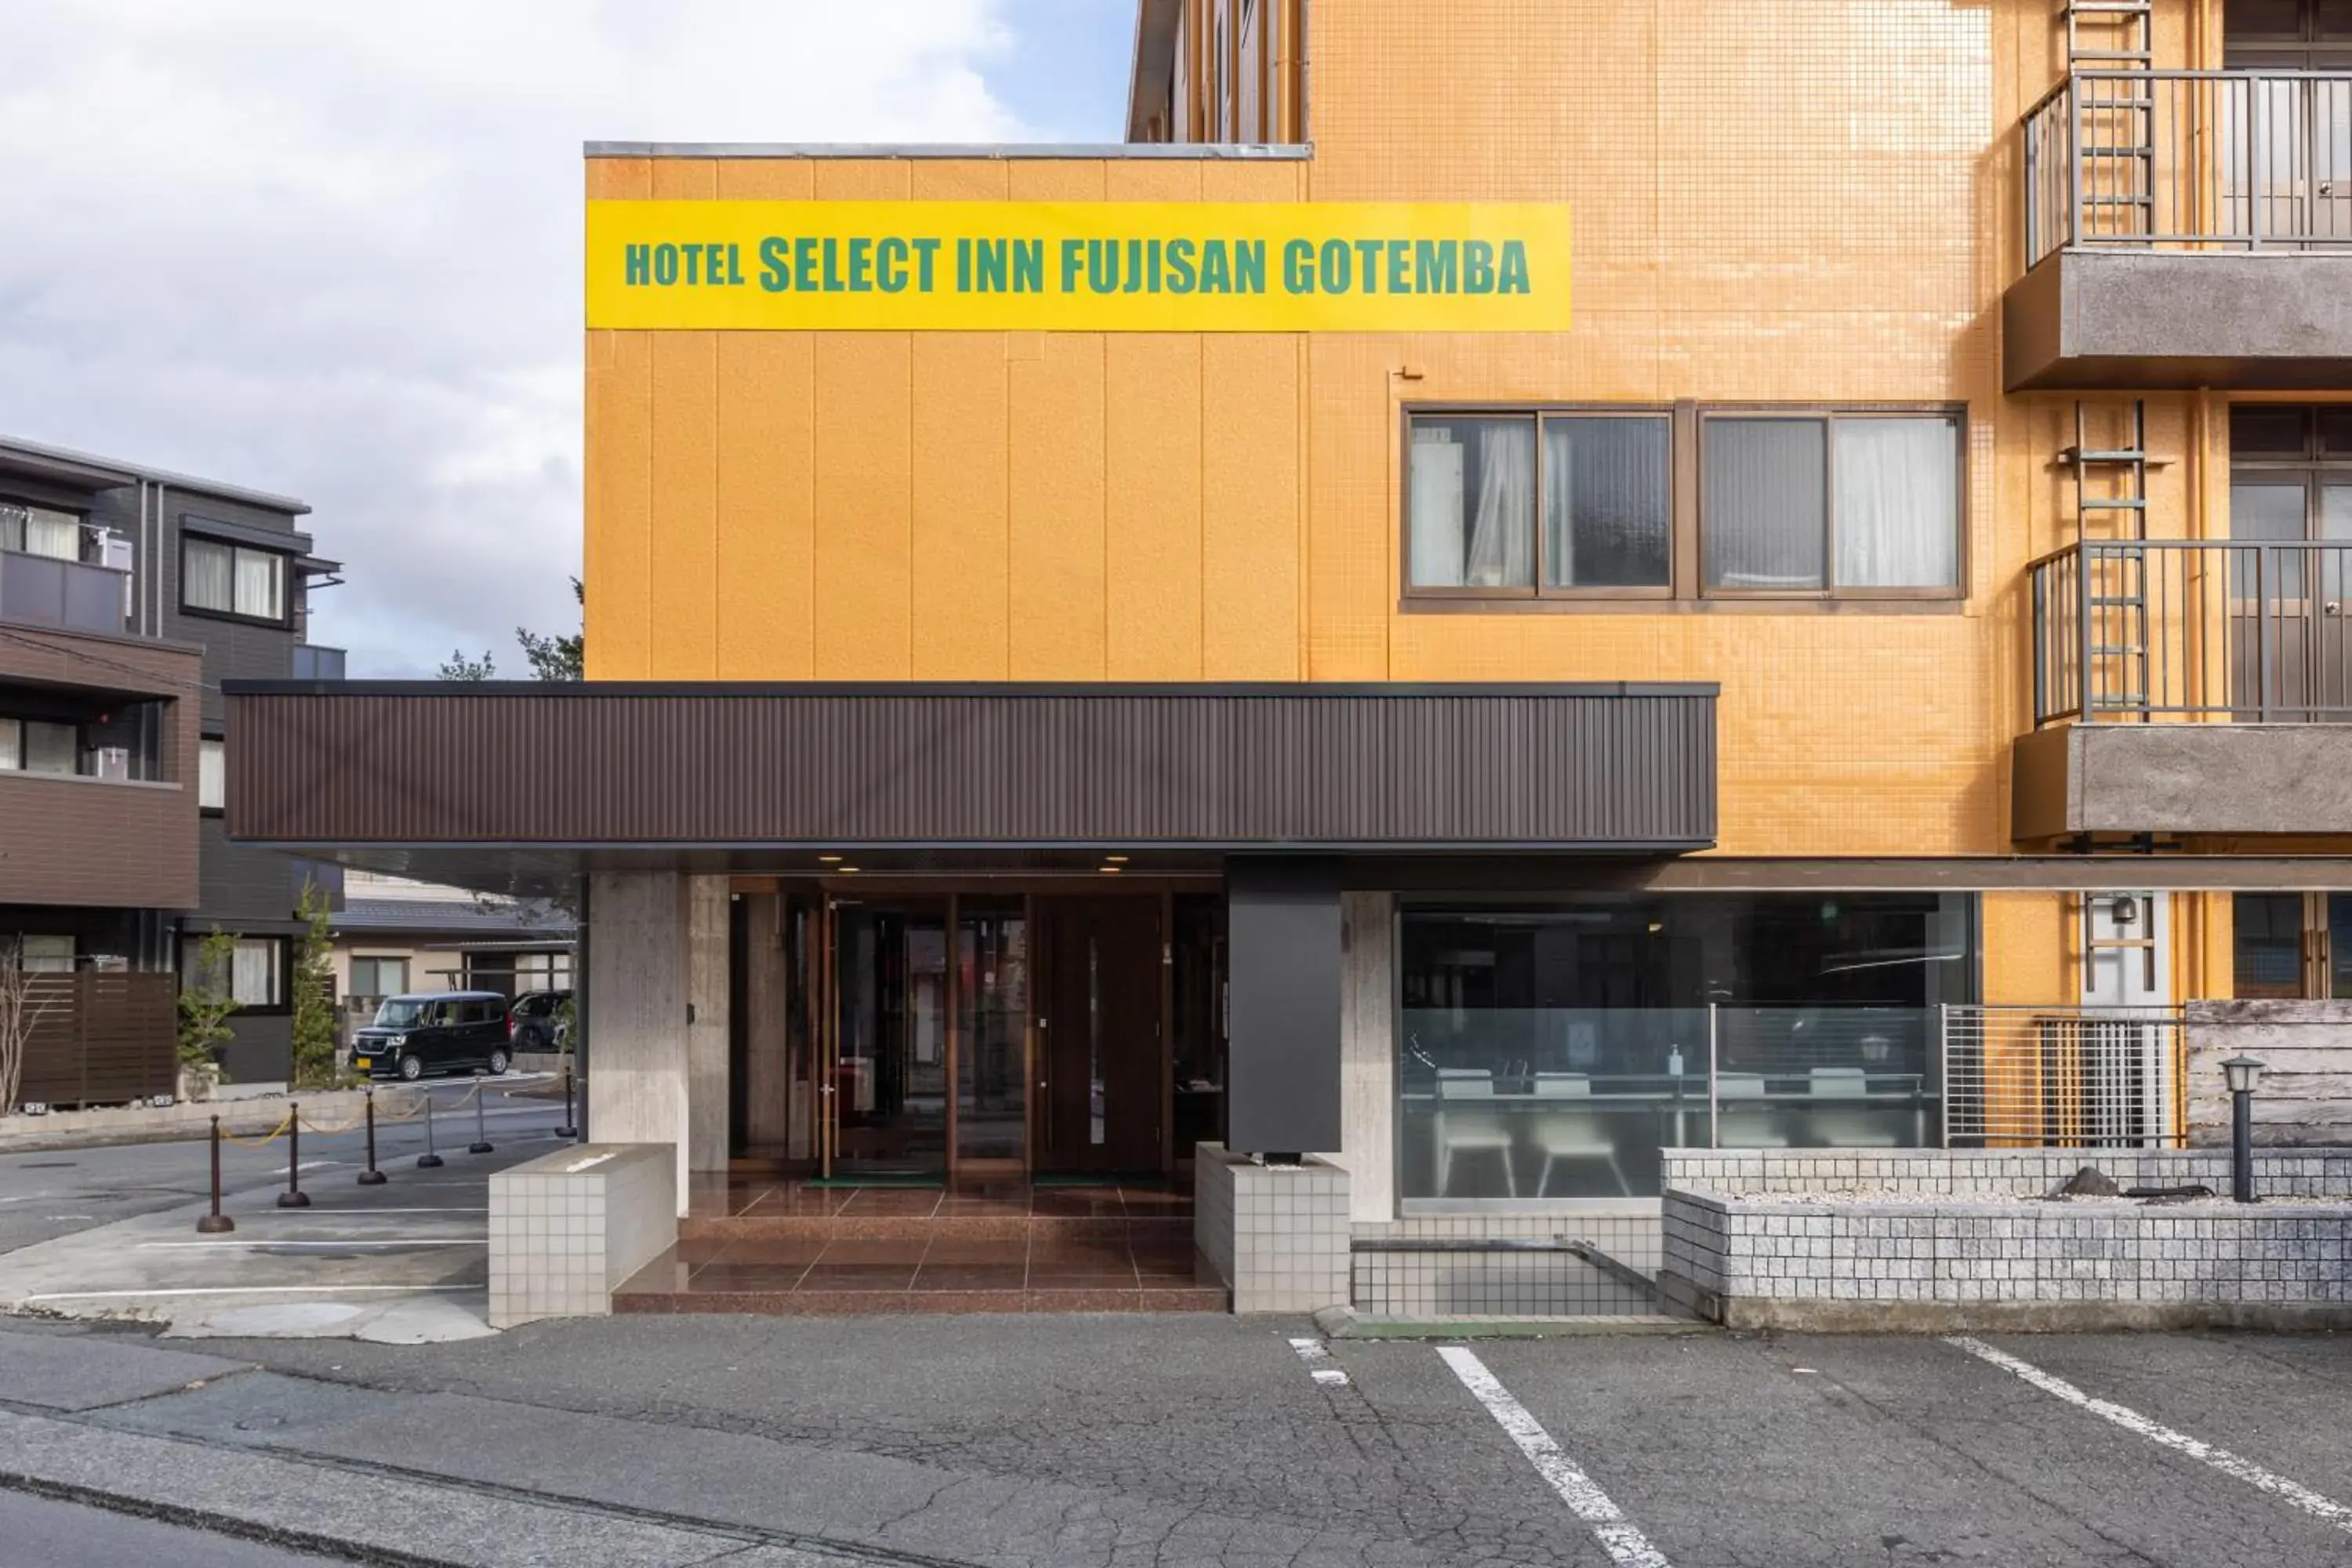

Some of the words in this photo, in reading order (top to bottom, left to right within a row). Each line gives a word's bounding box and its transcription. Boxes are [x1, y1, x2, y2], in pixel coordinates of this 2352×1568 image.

[626, 244, 745, 285] HOTEL
[759, 238, 941, 292] SELECT
[956, 239, 1044, 292] INN
[1061, 240, 1265, 293] FUJISAN
[1283, 239, 1530, 294] GOTEMBA
